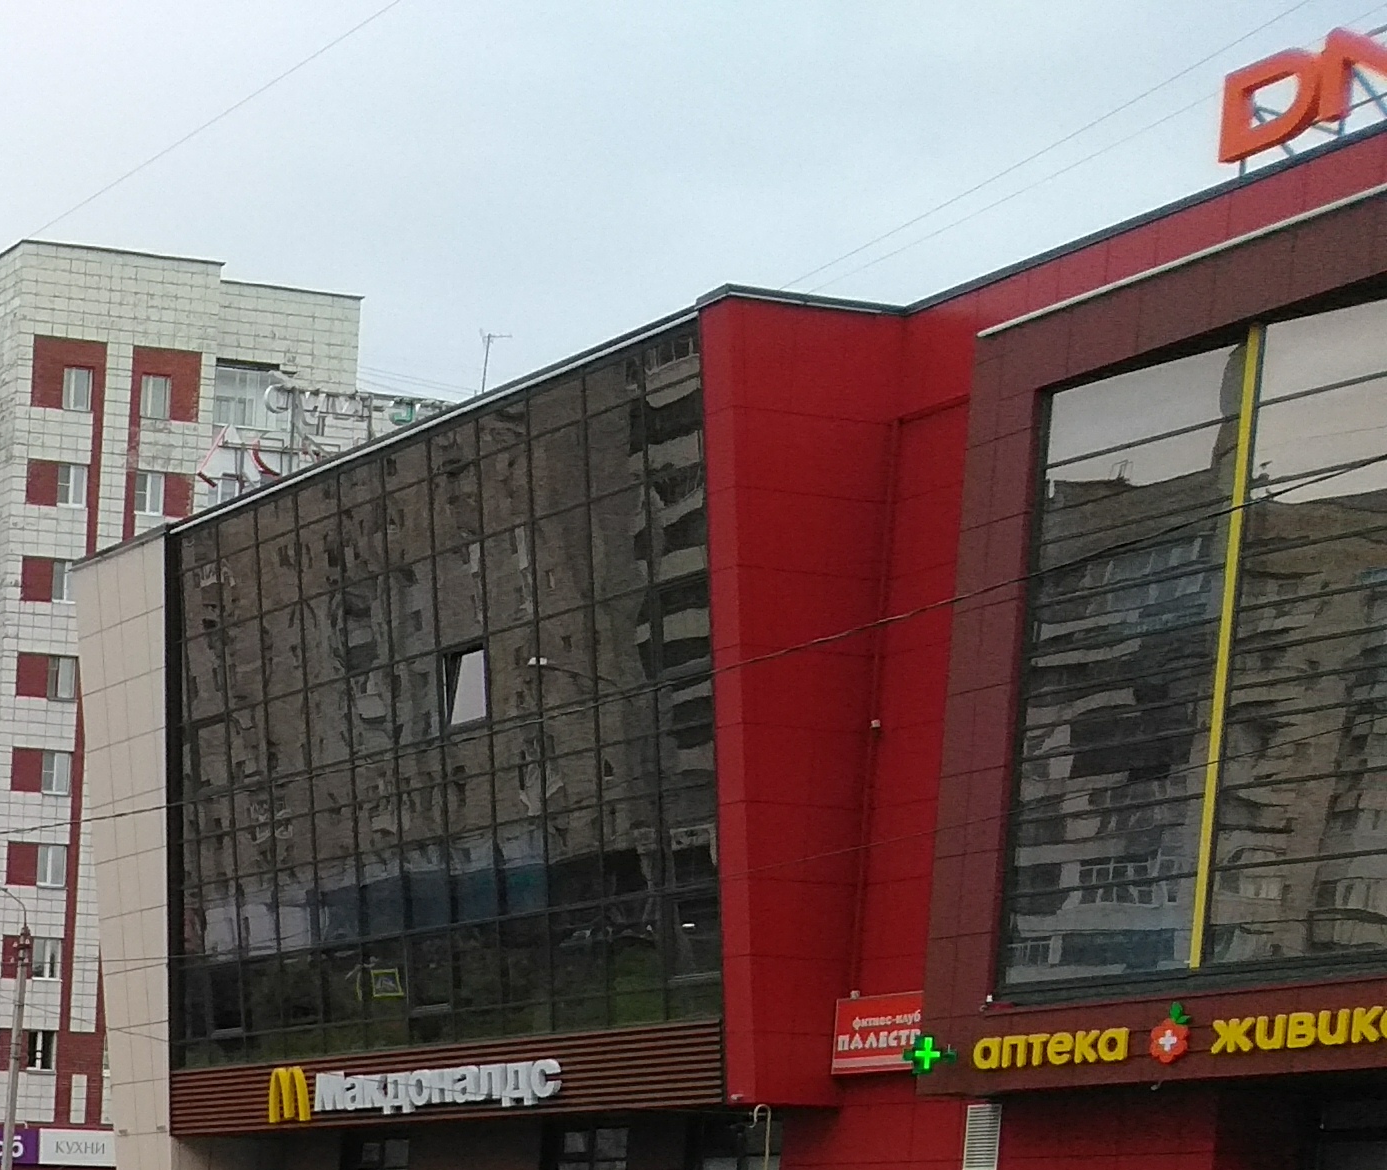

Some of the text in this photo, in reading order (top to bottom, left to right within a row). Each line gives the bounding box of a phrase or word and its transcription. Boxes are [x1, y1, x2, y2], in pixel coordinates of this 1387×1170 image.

[973, 1027, 1129, 1070] аптека
[314, 1058, 562, 1115] Макдоналдс
[55, 1140, 106, 1155] КУХНИ
